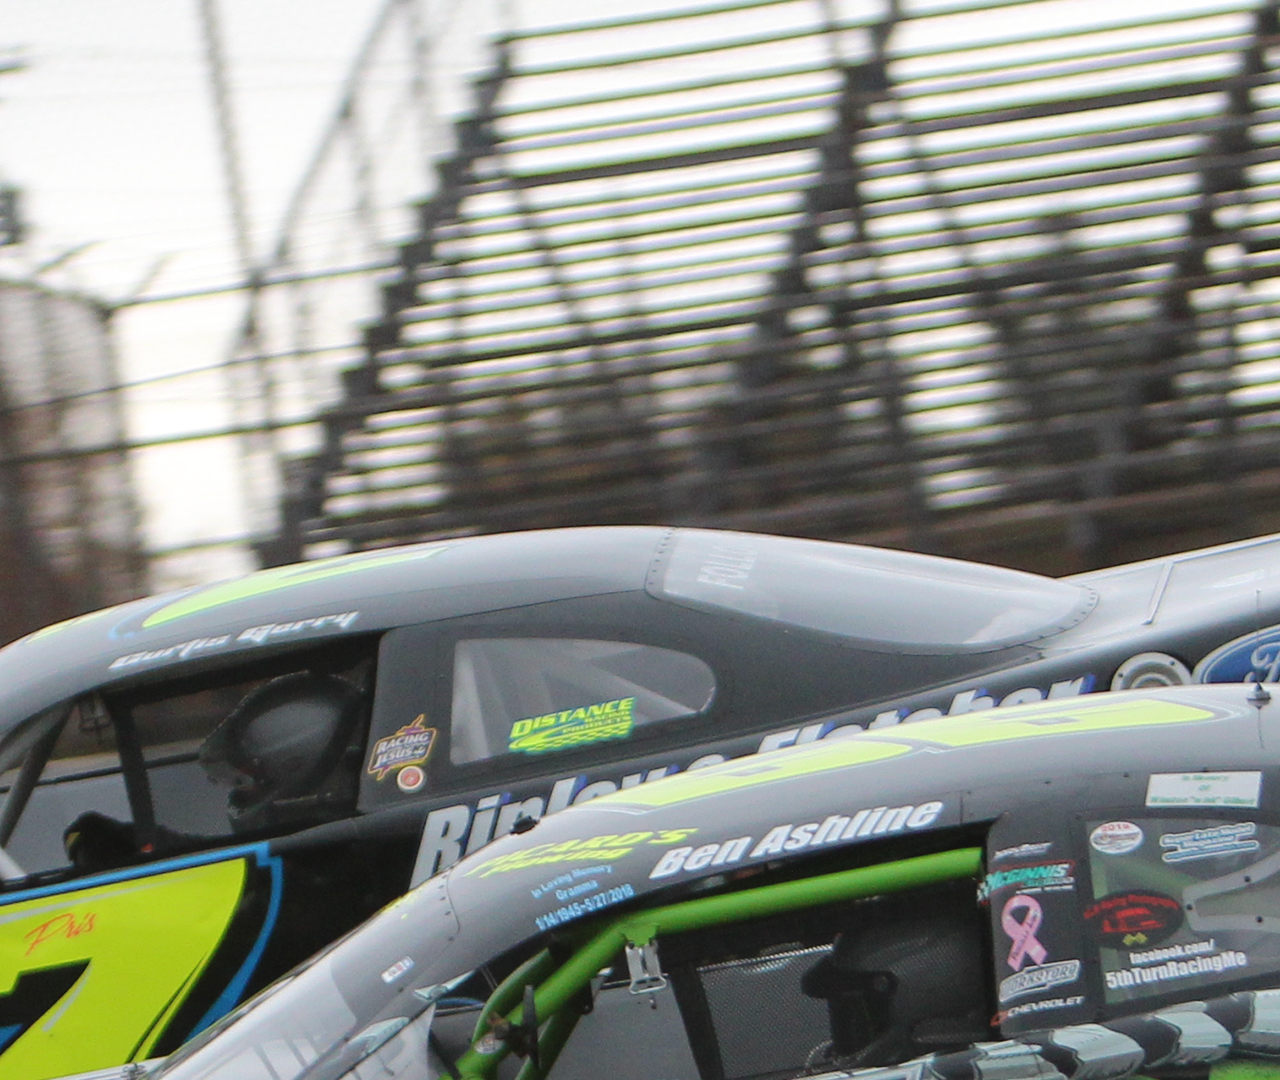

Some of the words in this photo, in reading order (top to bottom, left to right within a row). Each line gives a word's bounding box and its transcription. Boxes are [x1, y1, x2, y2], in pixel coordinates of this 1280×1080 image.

[509, 697, 636, 738] DISTANCE
[376, 732, 430, 755] RACING
[648, 835, 754, 879] Ben
[749, 800, 944, 857] Ashline
[541, 873, 573, 892] Loving
[555, 880, 599, 900] Gramma
[1129, 937, 1216, 965] facebook.com/
[1105, 950, 1248, 989] 5thTurnRacingMe
[1007, 995, 1085, 1018] CHEVROLET
